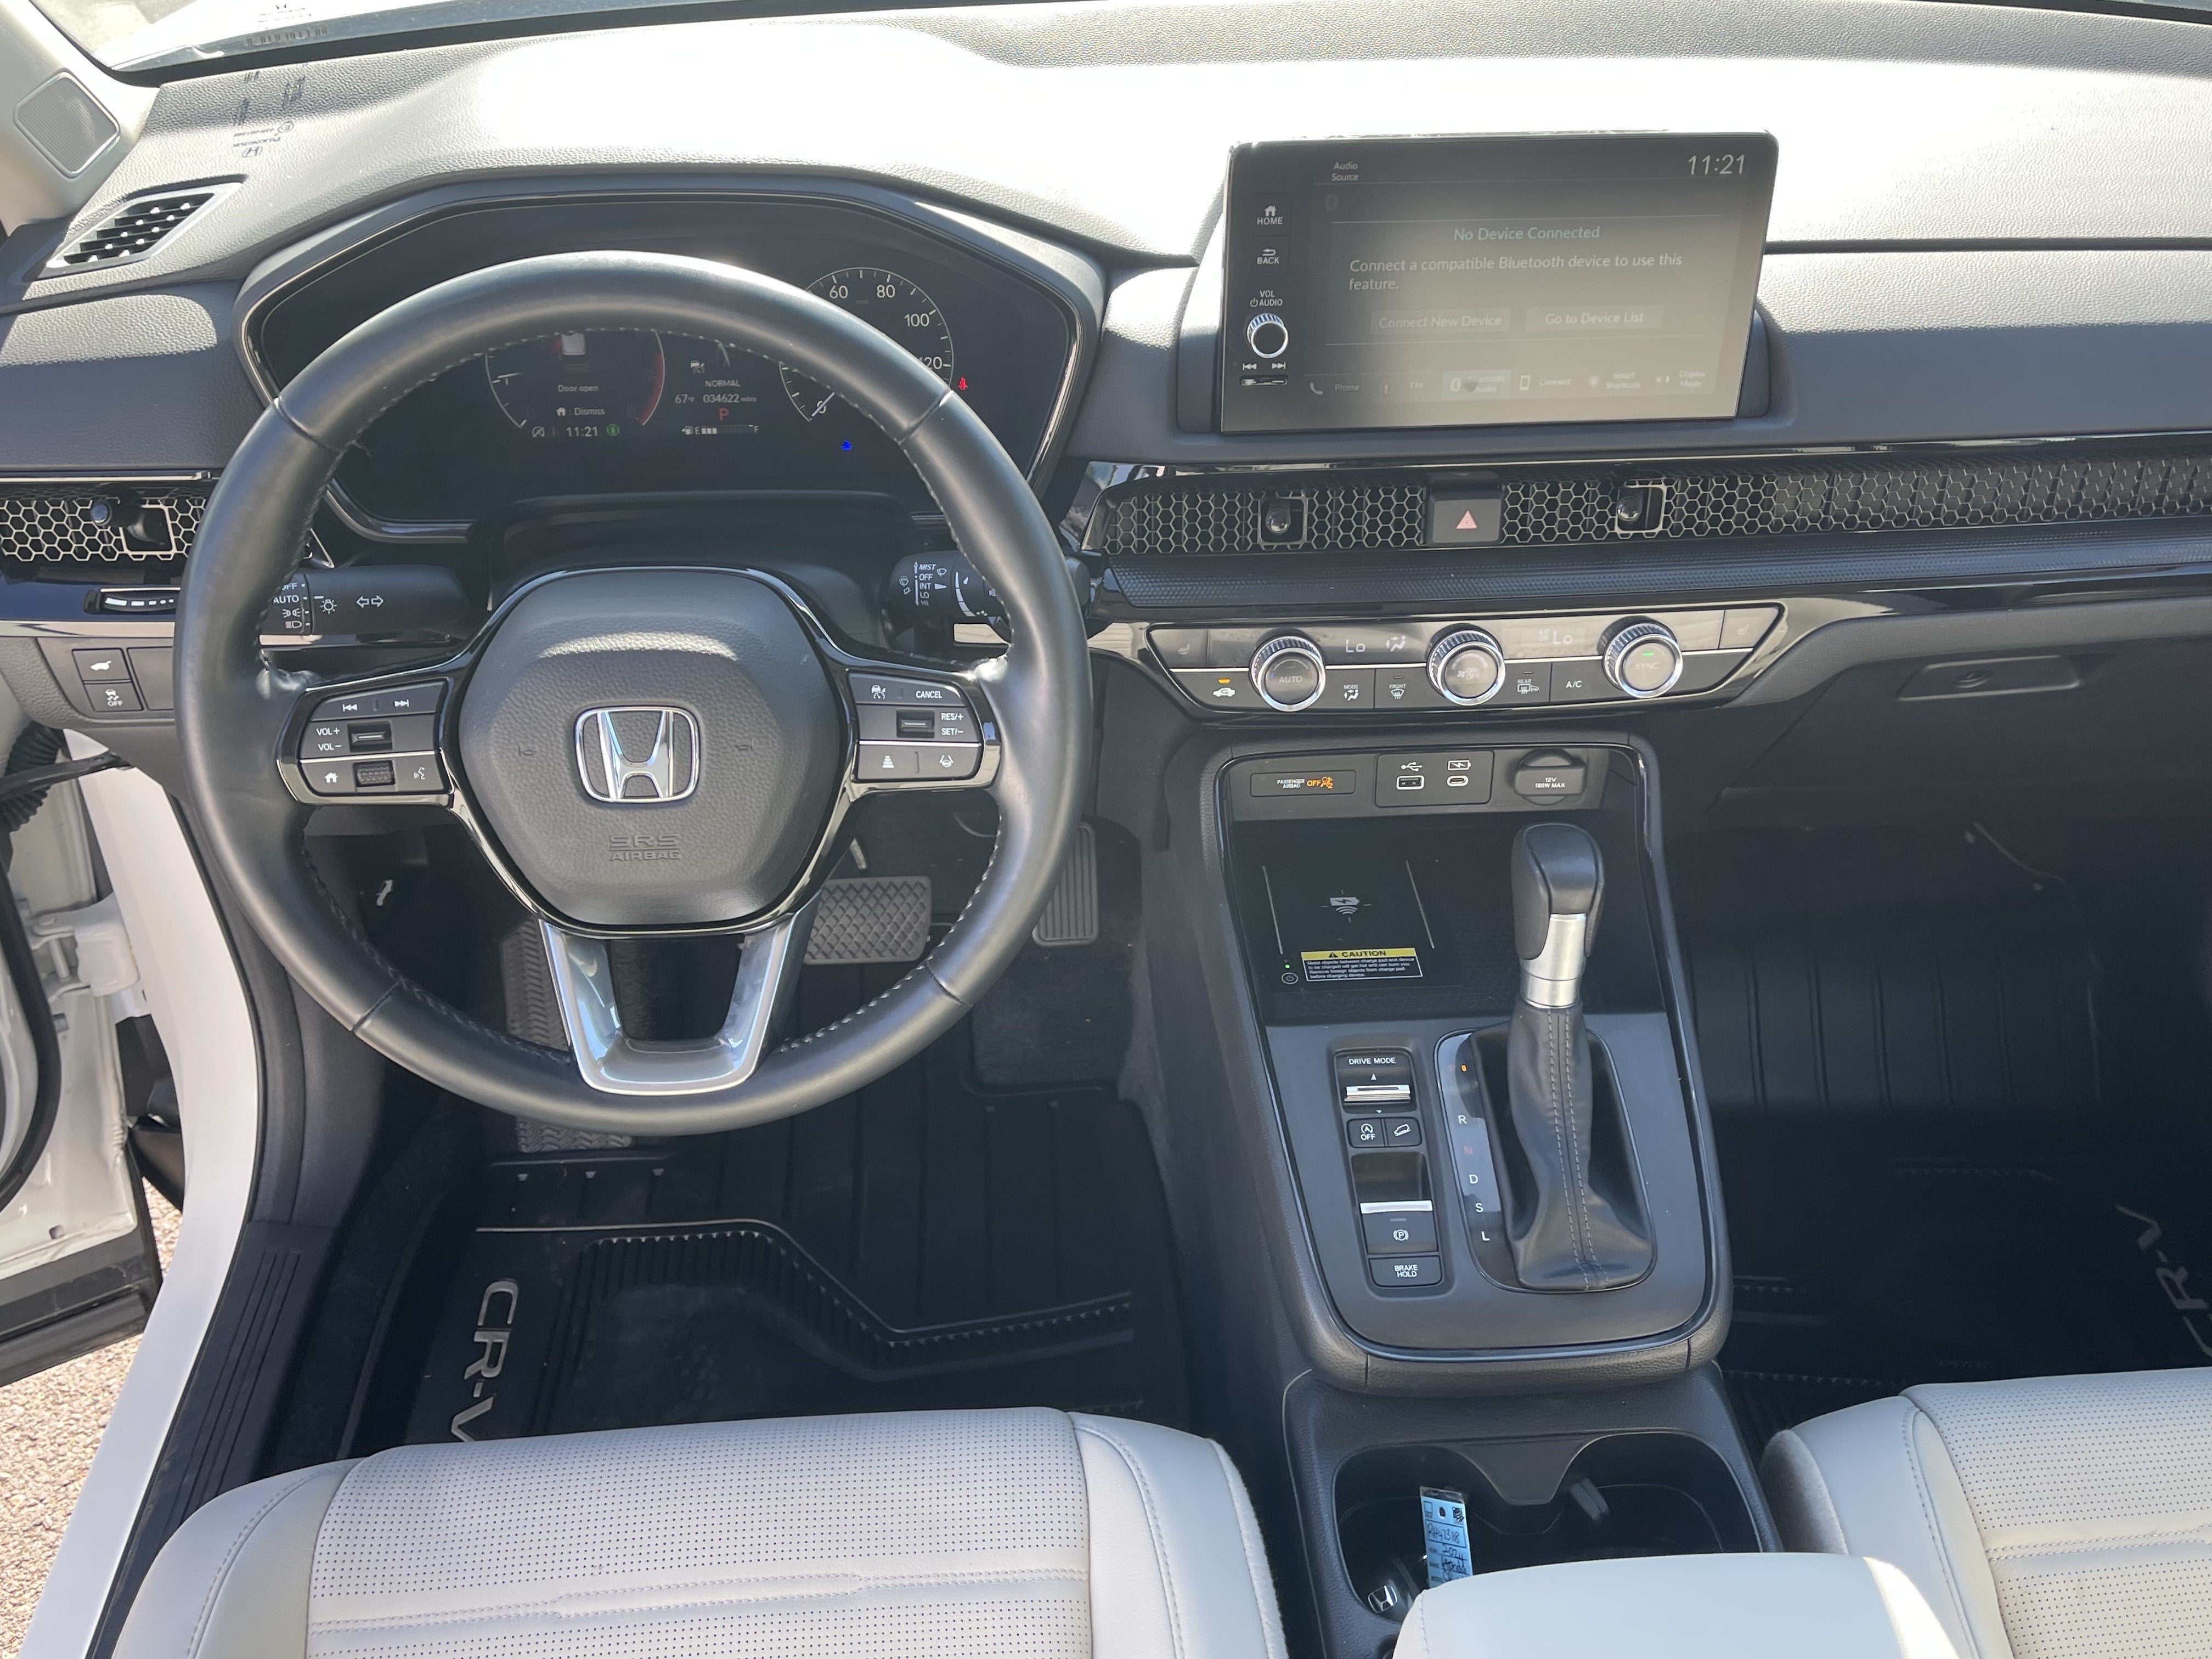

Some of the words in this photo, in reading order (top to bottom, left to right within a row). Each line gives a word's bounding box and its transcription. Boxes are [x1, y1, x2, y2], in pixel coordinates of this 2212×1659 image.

[1333, 161, 1358, 170] Audio
[1688, 154, 1745, 174] 11:21
[1331, 173, 1358, 181] Source
[1454, 229, 1473, 241] No
[1478, 227, 1523, 240] Device
[1528, 226, 1600, 239] Connected
[1350, 259, 1406, 272] Connect
[1409, 262, 1417, 271] a
[1421, 257, 1494, 272] compatible
[1499, 255, 1565, 269] Bluetooth
[1568, 255, 1610, 267] device
[1615, 255, 1628, 267] to
[1633, 256, 1655, 266] use
[1659, 253, 1682, 266] this
[1349, 278, 1400, 290] feature.
[829, 285, 848, 299] 60
[877, 285, 896, 298] 80
[905, 313, 929, 328] 100
[1379, 318, 1427, 329] Connect
[1431, 317, 1458, 328] New
[1462, 315, 1502, 326] Device
[1545, 313, 1562, 325] Go
[1566, 313, 1577, 324] to
[1581, 312, 1619, 324] Device
[1623, 312, 1645, 323] List
[1679, 370, 1707, 379] Display
[706, 379, 741, 387] NORMAL
[1335, 383, 1359, 392] Phone
[703, 393, 740, 403] 034622
[574, 408, 605, 416] Dismiss
[719, 408, 729, 421] P
[566, 426, 598, 437] 11:21
[695, 426, 700, 435] E
[754, 425, 760, 433] F
[273, 595, 300, 604] AUTO
[1346, 639, 1365, 653] Lo
[1566, 680, 1582, 689] A/C
[916, 691, 942, 699] CANCEL
[941, 713, 963, 721] RES/+
[609, 833, 678, 848] SRS
[610, 850, 681, 861] AIRBAG
[1458, 1115, 1468, 1125] R
[1469, 1174, 1479, 1184] D
[1475, 1203, 1484, 1213] S
[1481, 1231, 1490, 1241] L
[451, 1279, 518, 1442] CR-V
